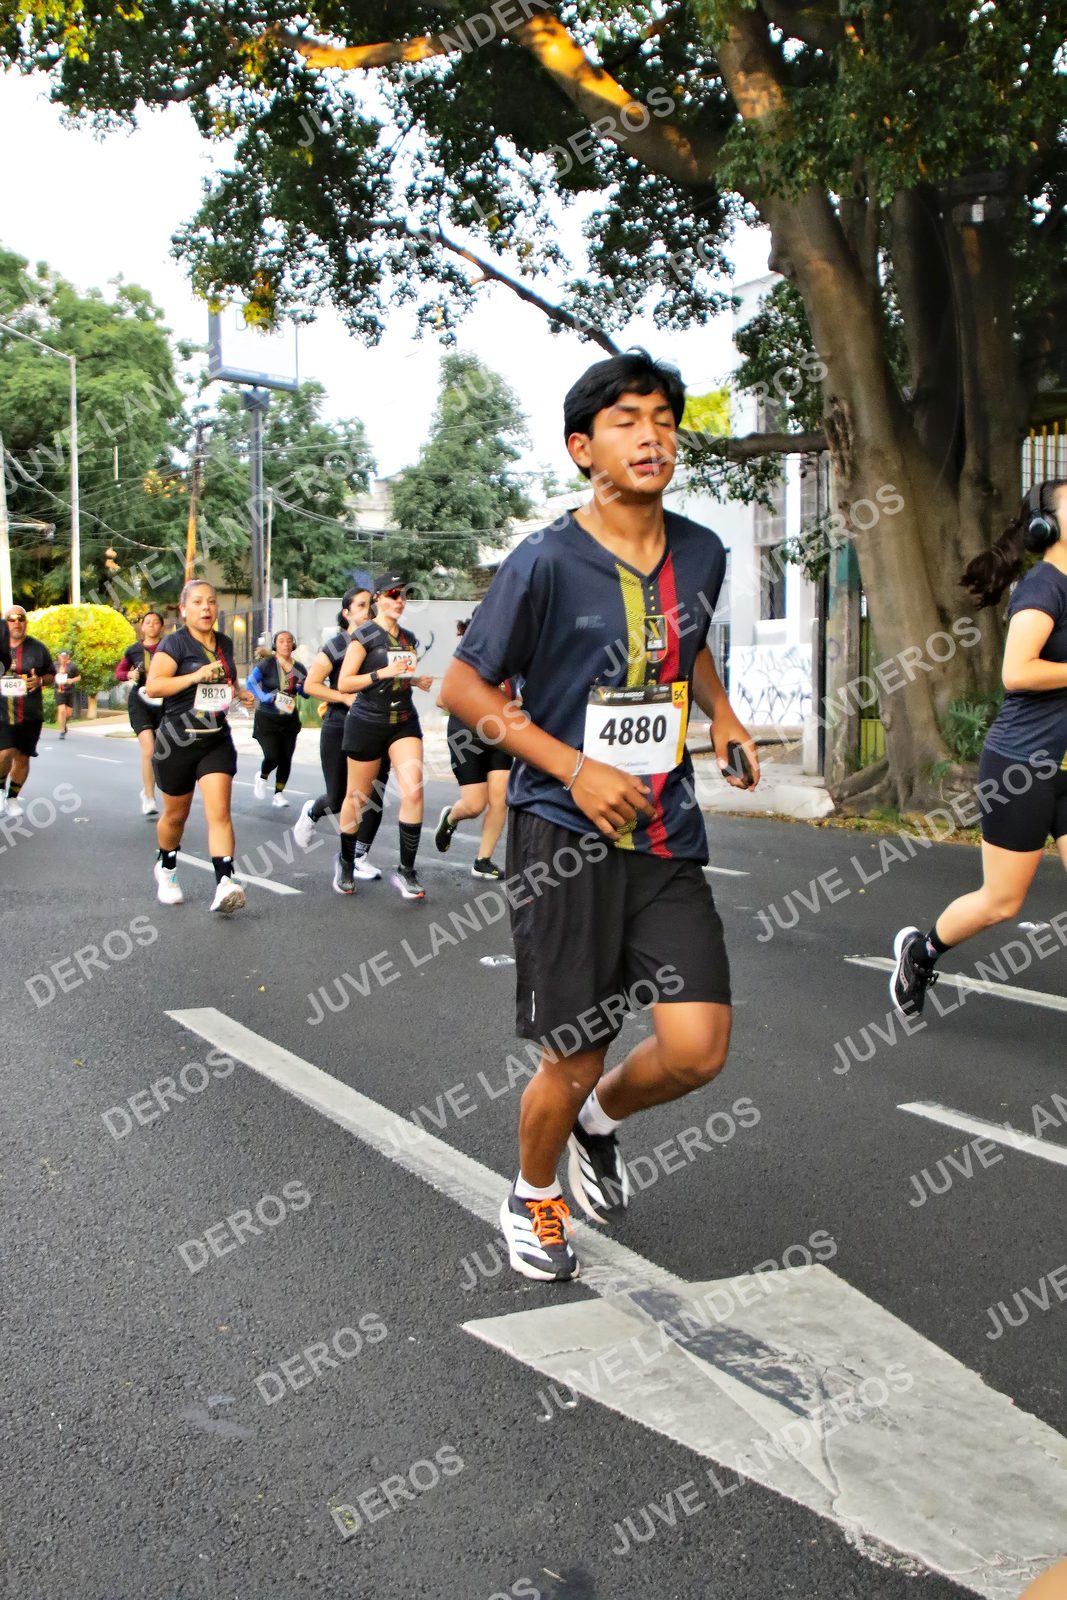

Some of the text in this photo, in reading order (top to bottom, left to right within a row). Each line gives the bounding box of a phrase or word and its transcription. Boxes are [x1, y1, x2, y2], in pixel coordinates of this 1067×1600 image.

[4, 681, 22, 689] 4847
[201, 687, 226, 699] 9820
[599, 714, 667, 746] 4880
